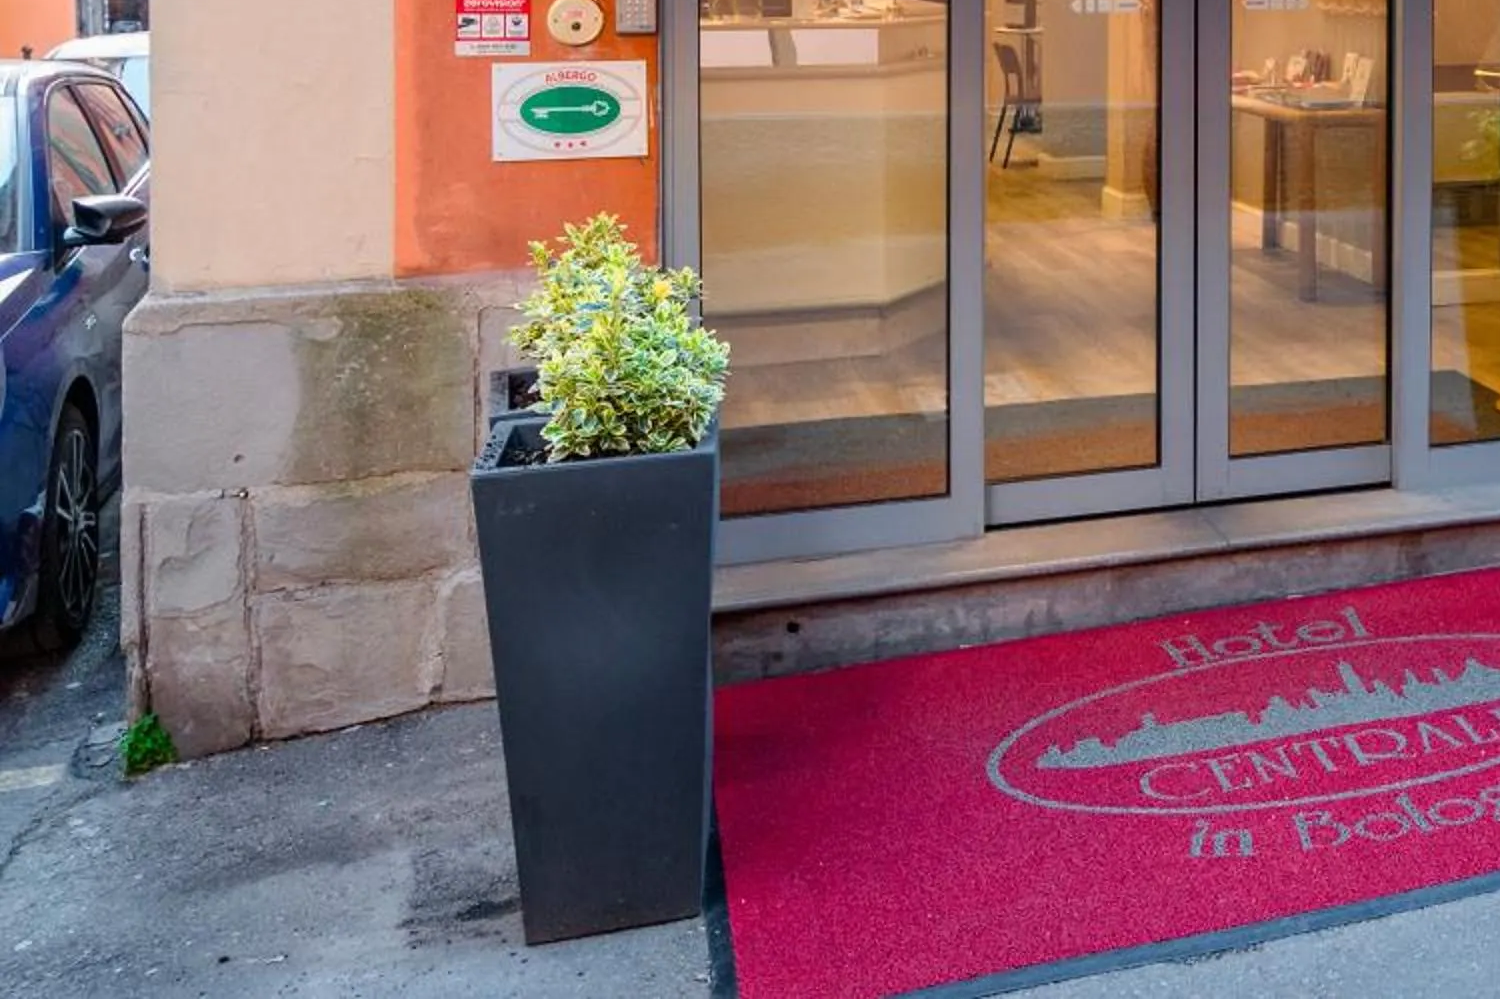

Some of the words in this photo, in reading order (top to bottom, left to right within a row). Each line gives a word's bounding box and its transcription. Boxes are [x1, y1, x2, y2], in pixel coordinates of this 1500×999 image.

[545, 71, 598, 83] ALBERGO
[1161, 605, 1373, 669] Hotel
[1189, 818, 1256, 858] in
